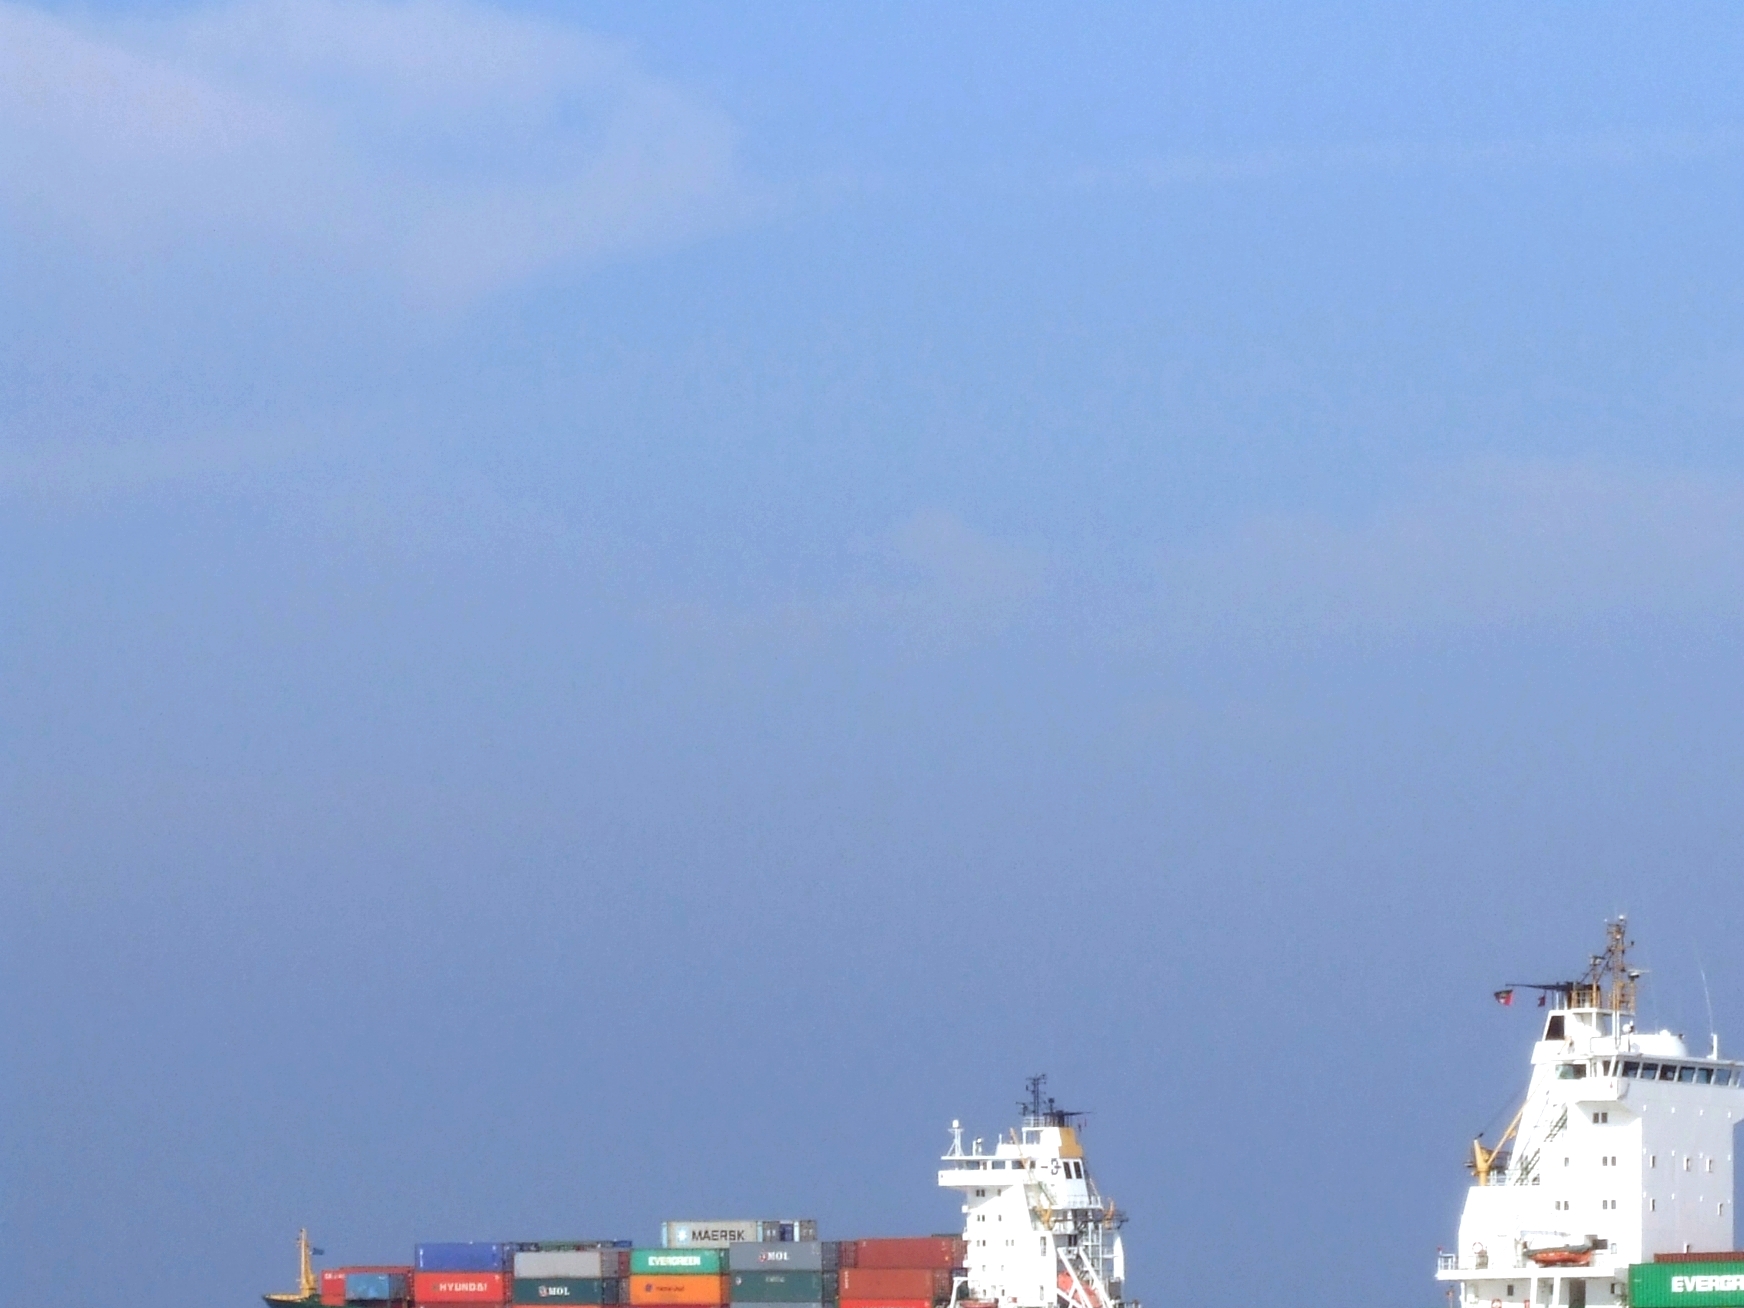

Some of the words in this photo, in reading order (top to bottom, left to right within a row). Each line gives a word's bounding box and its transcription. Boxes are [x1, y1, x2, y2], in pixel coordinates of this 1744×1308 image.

[691, 1230, 745, 1241] MAERSK
[648, 1256, 701, 1266] EVERGREEN
[767, 1251, 789, 1261] MOL
[439, 1283, 488, 1292] HYUNDAI
[548, 1286, 570, 1296] MOL
